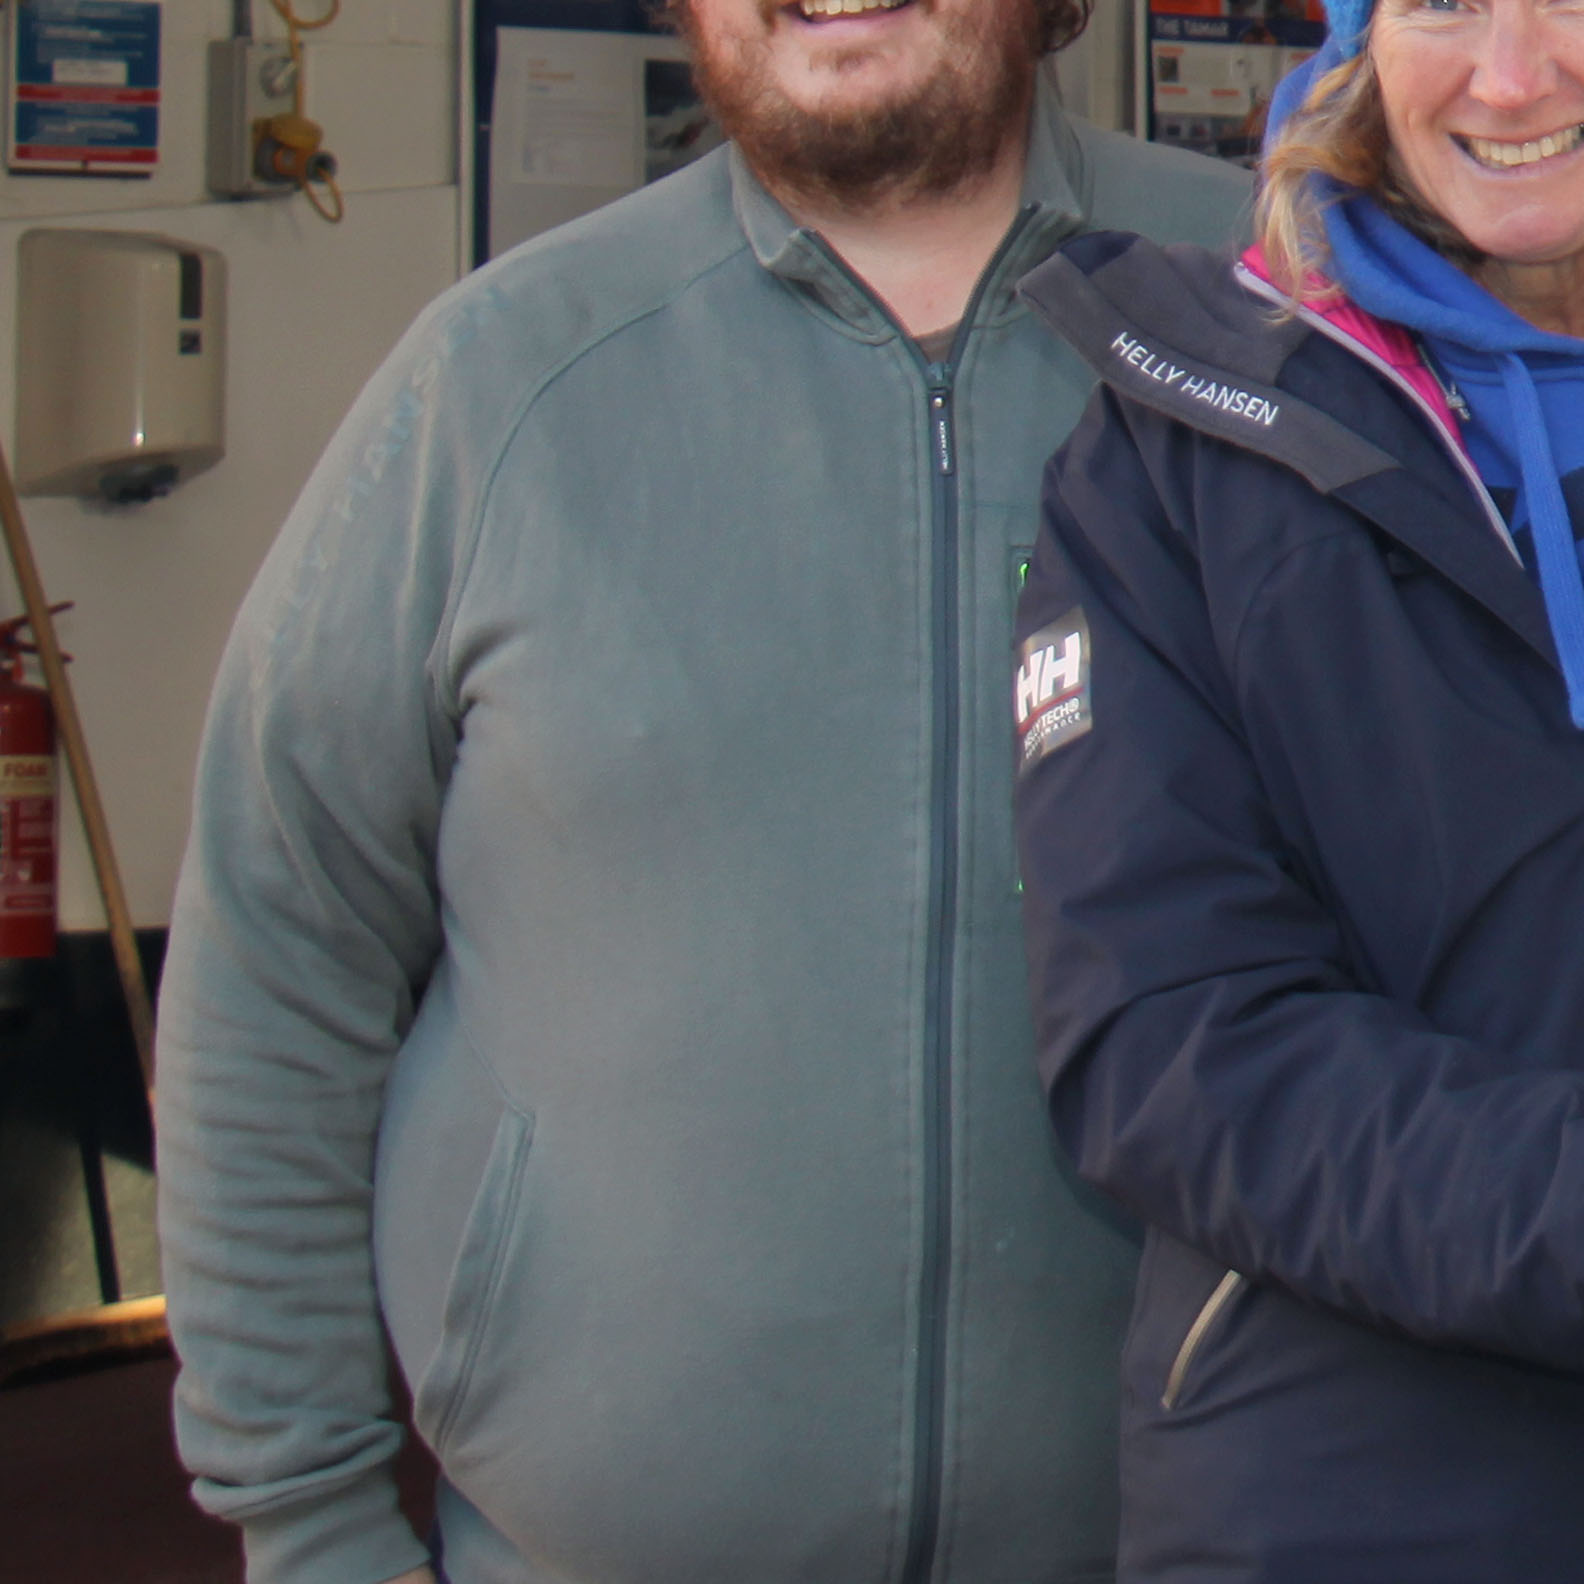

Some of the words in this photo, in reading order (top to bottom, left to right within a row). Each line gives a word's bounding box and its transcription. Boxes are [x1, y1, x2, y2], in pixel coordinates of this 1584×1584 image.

[1111, 331, 1180, 384] HELLY
[1180, 378, 1279, 426] HANSEN
[1016, 632, 1081, 724] HH
